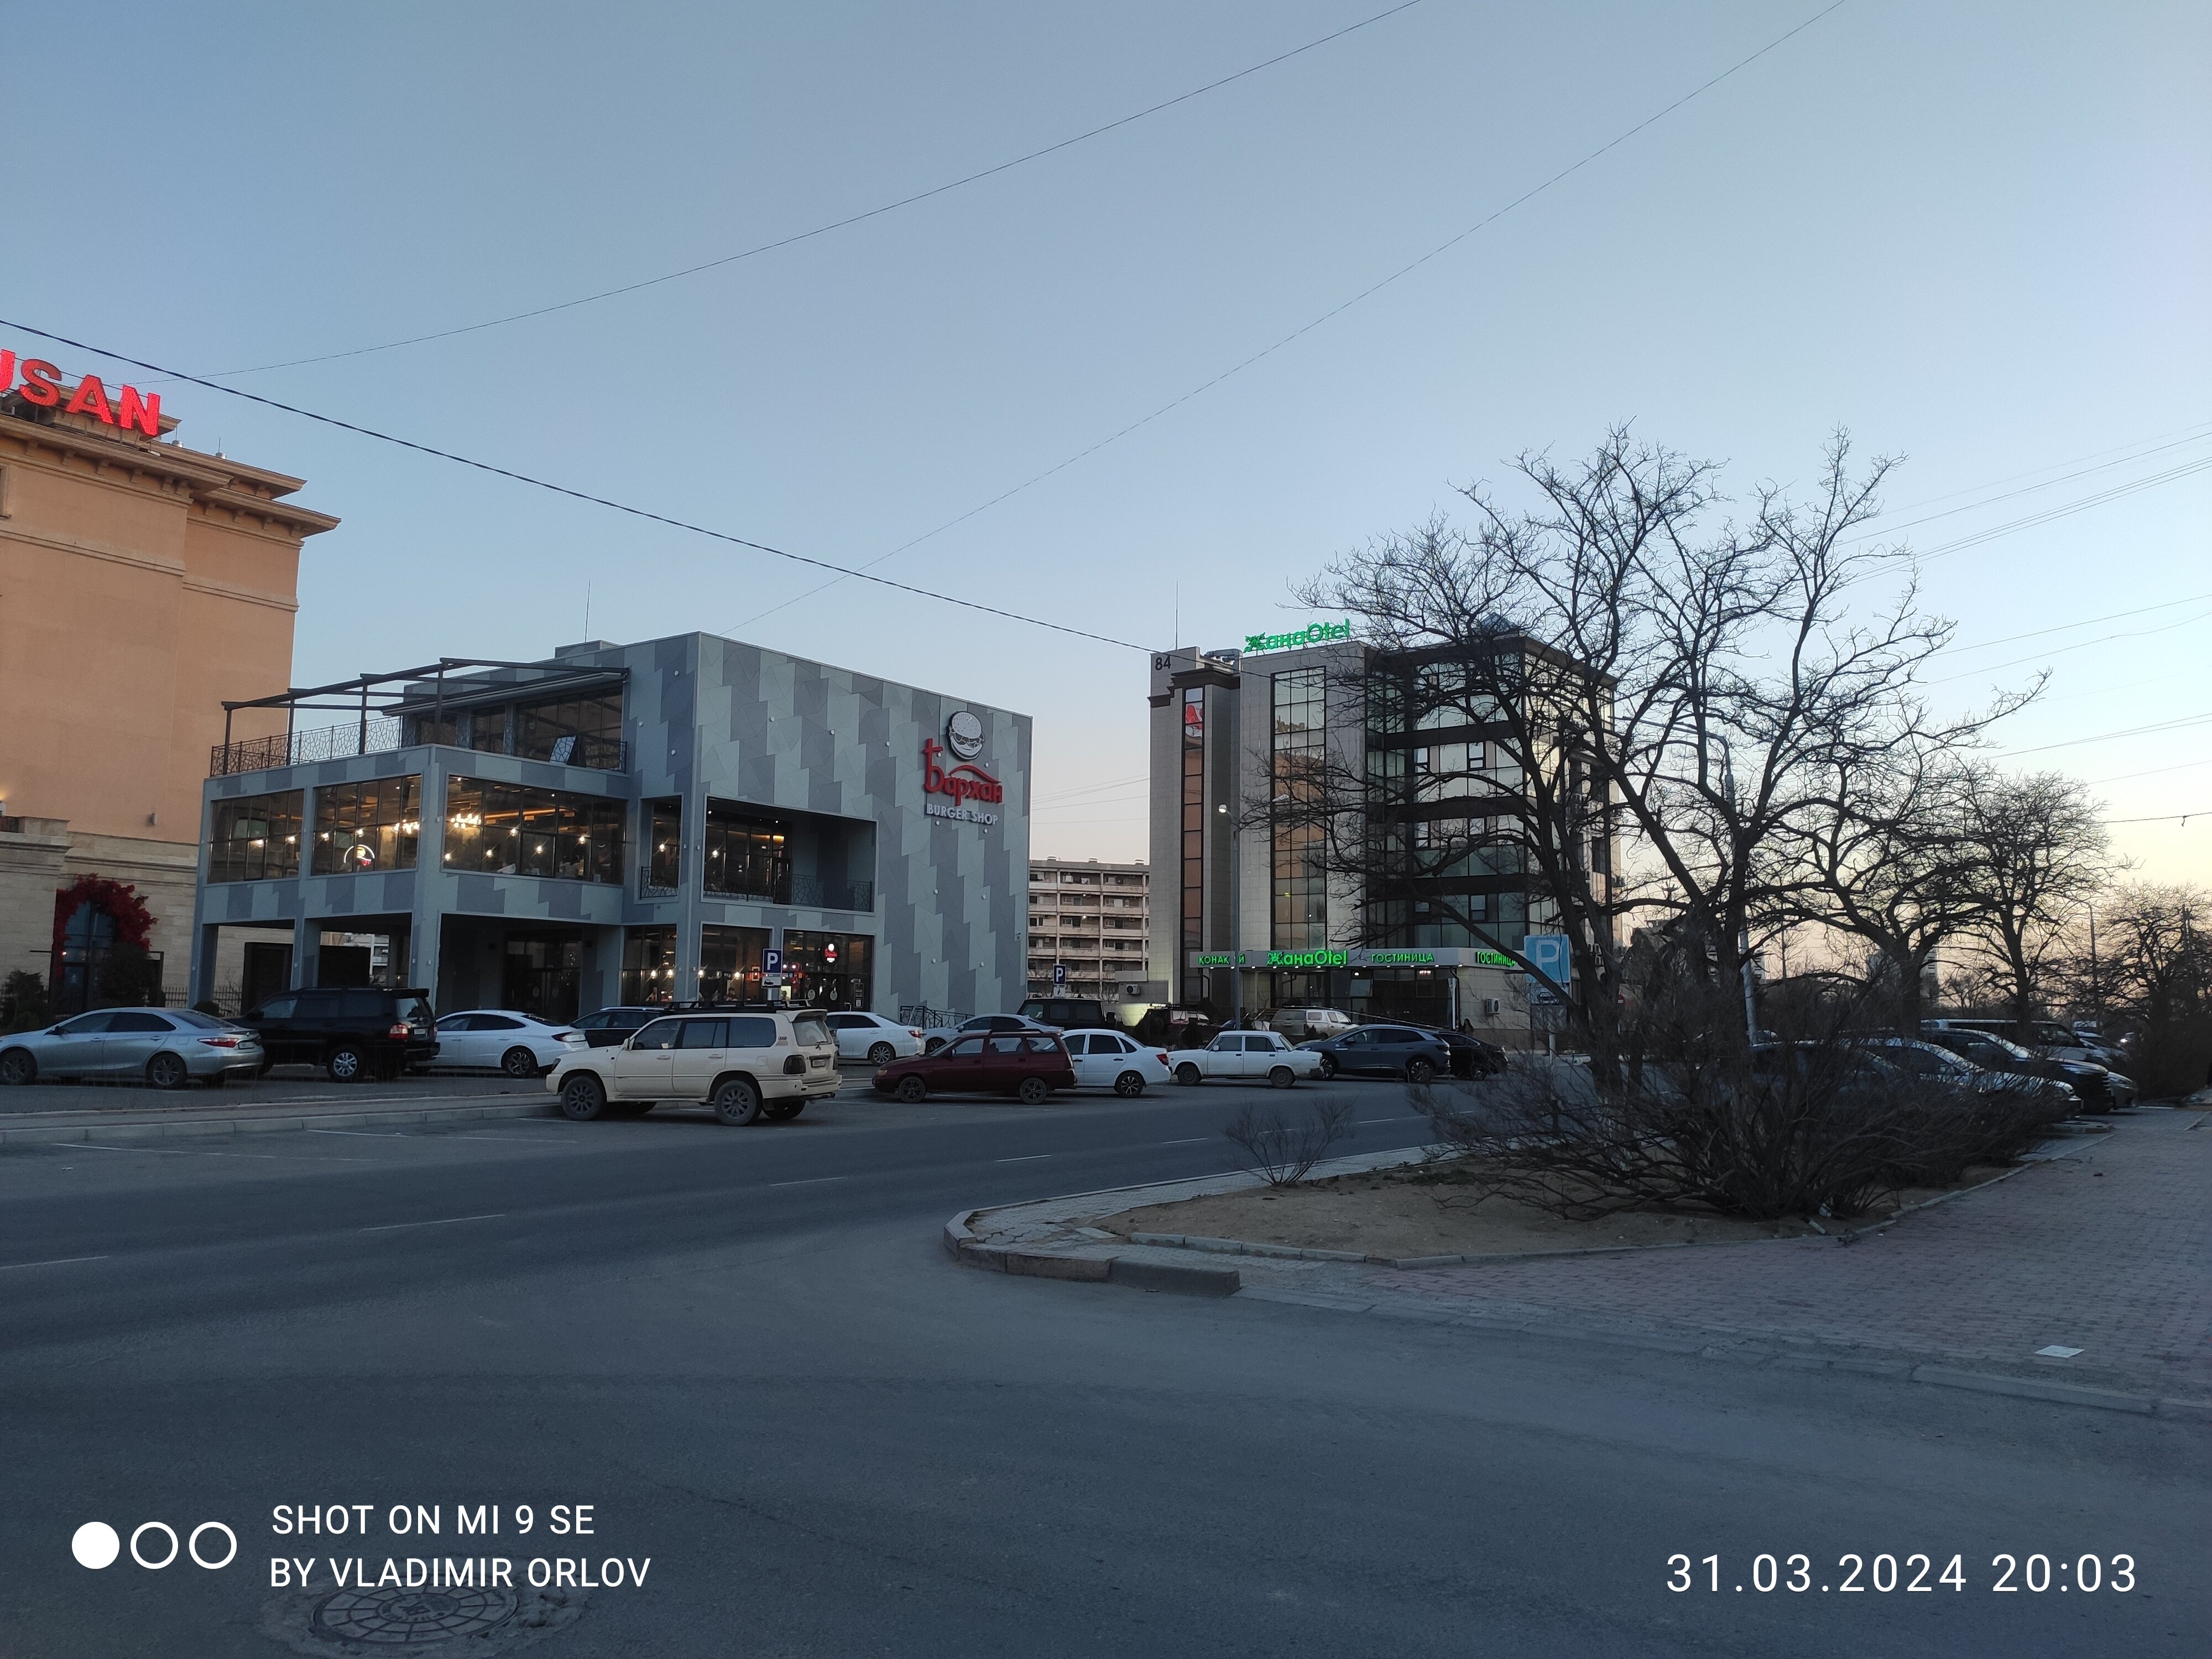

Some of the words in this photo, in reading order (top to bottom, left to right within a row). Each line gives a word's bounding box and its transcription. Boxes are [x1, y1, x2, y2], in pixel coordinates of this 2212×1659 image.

[1155, 655, 1171, 671] 84
[926, 803, 967, 820] BURGER
[971, 811, 998, 825] SHOP
[767, 952, 778, 971] P
[1371, 953, 1434, 963] ГОСТИНИЦА
[1056, 967, 1063, 982] P
